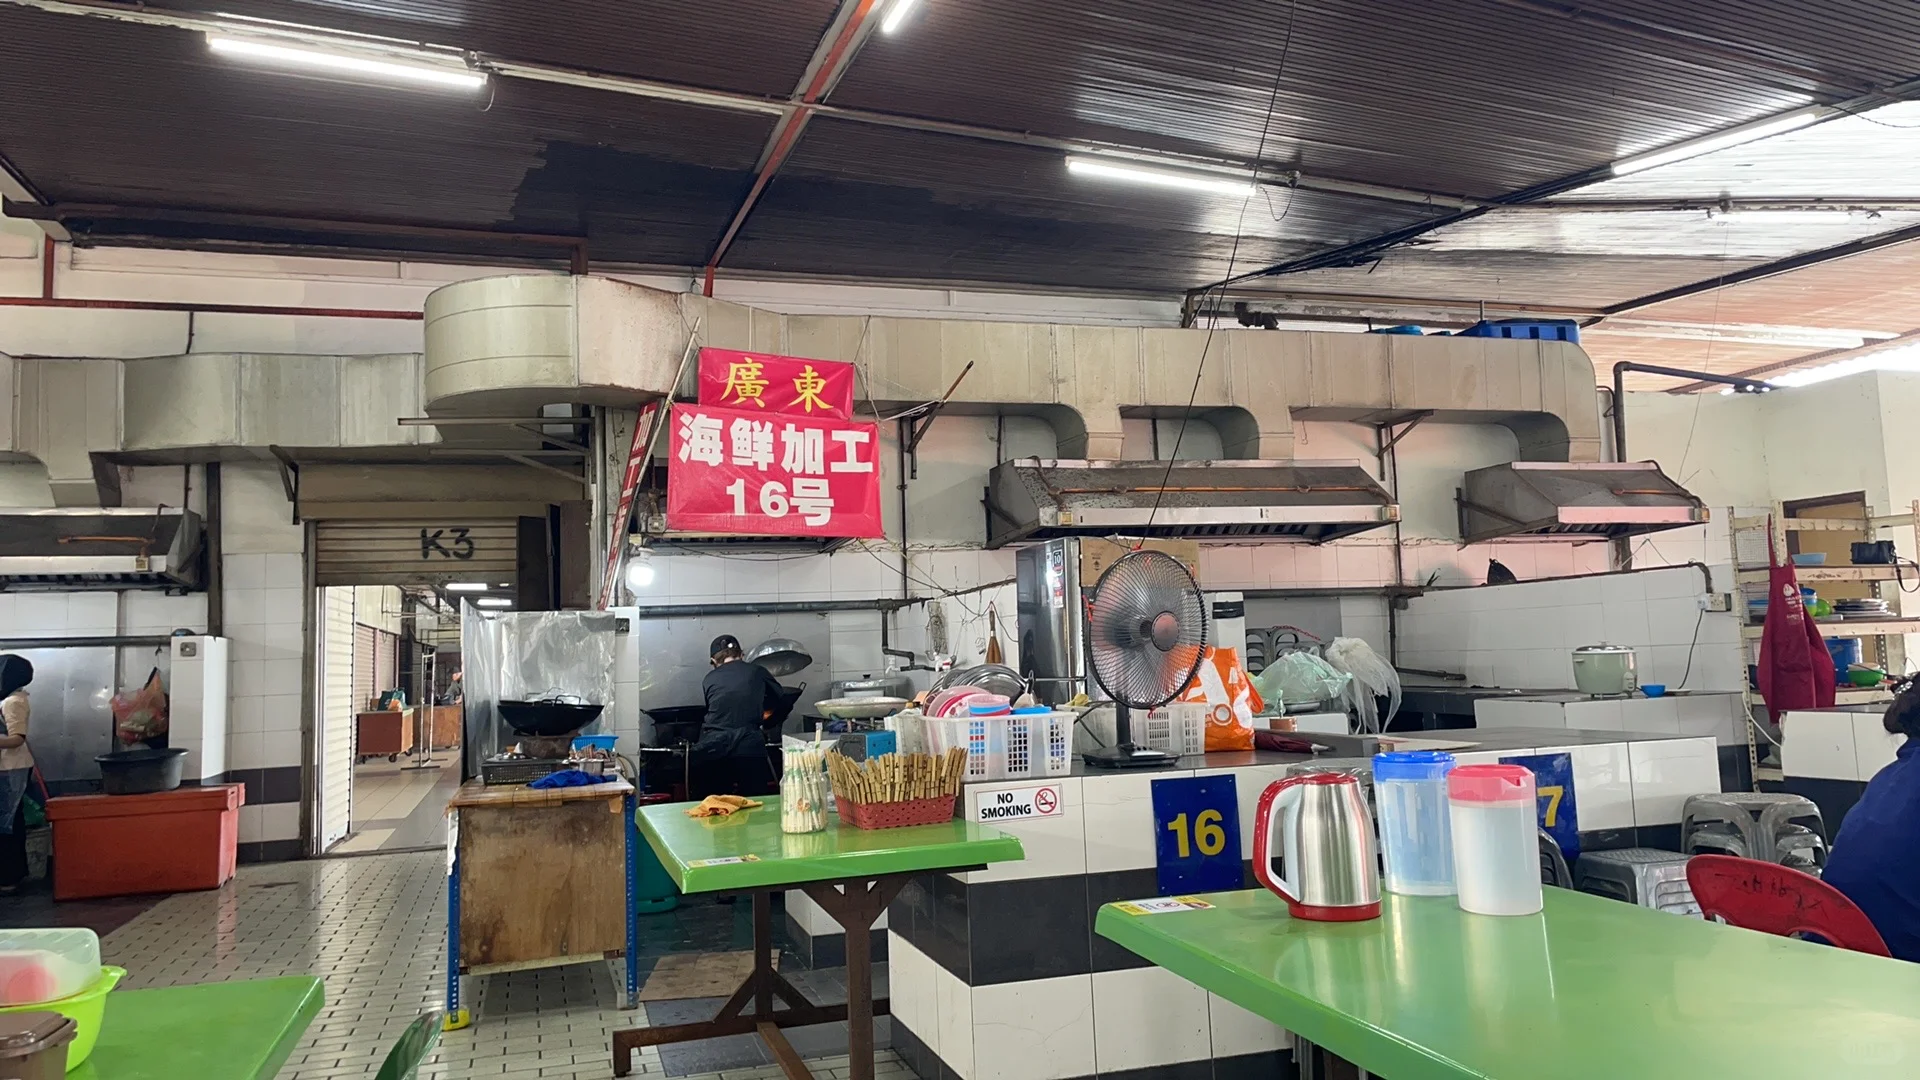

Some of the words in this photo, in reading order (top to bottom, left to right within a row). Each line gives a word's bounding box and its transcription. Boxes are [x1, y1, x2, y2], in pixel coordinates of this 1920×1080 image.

[720, 356, 834, 413] 廣東
[678, 411, 874, 475] 海鲜加工
[421, 527, 474, 559] K3
[981, 804, 1031, 819] SMOKING
[997, 792, 1014, 804] NO
[1537, 785, 1563, 827] 7
[1167, 809, 1225, 857] 16
